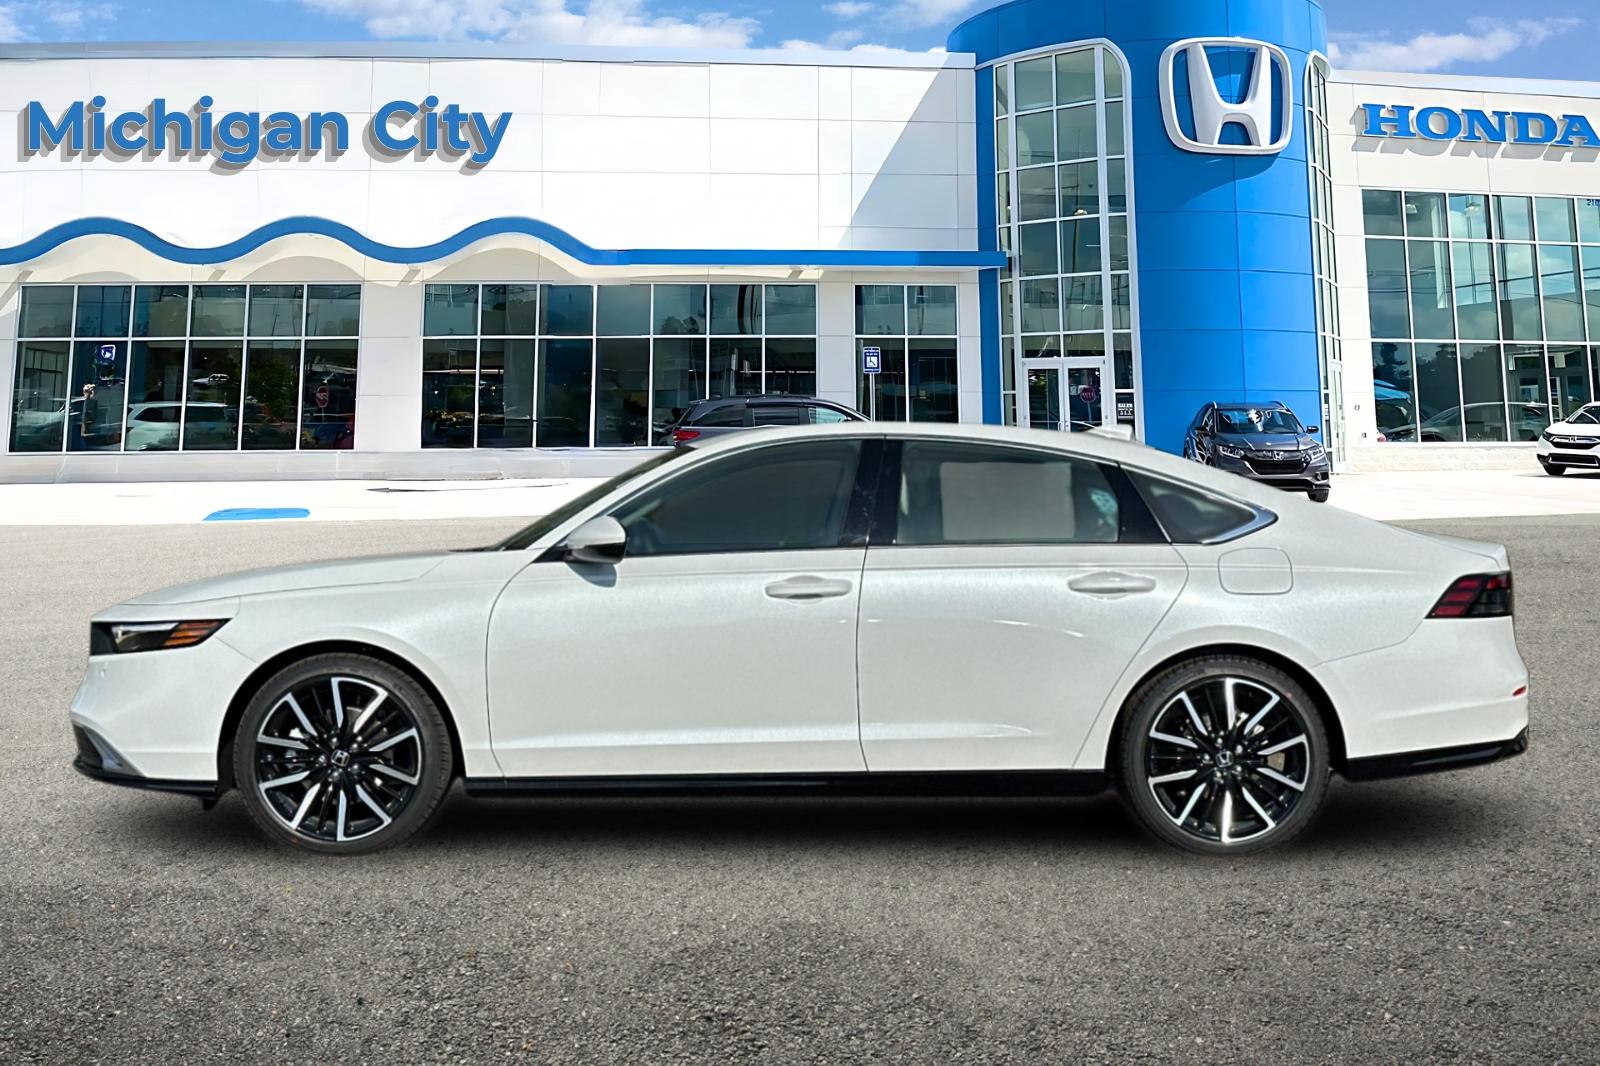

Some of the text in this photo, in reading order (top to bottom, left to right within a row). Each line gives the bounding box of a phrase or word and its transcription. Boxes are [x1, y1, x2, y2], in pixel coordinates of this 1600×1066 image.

[28, 95, 513, 164] Michigan City
[1361, 103, 1600, 148] HONDA
